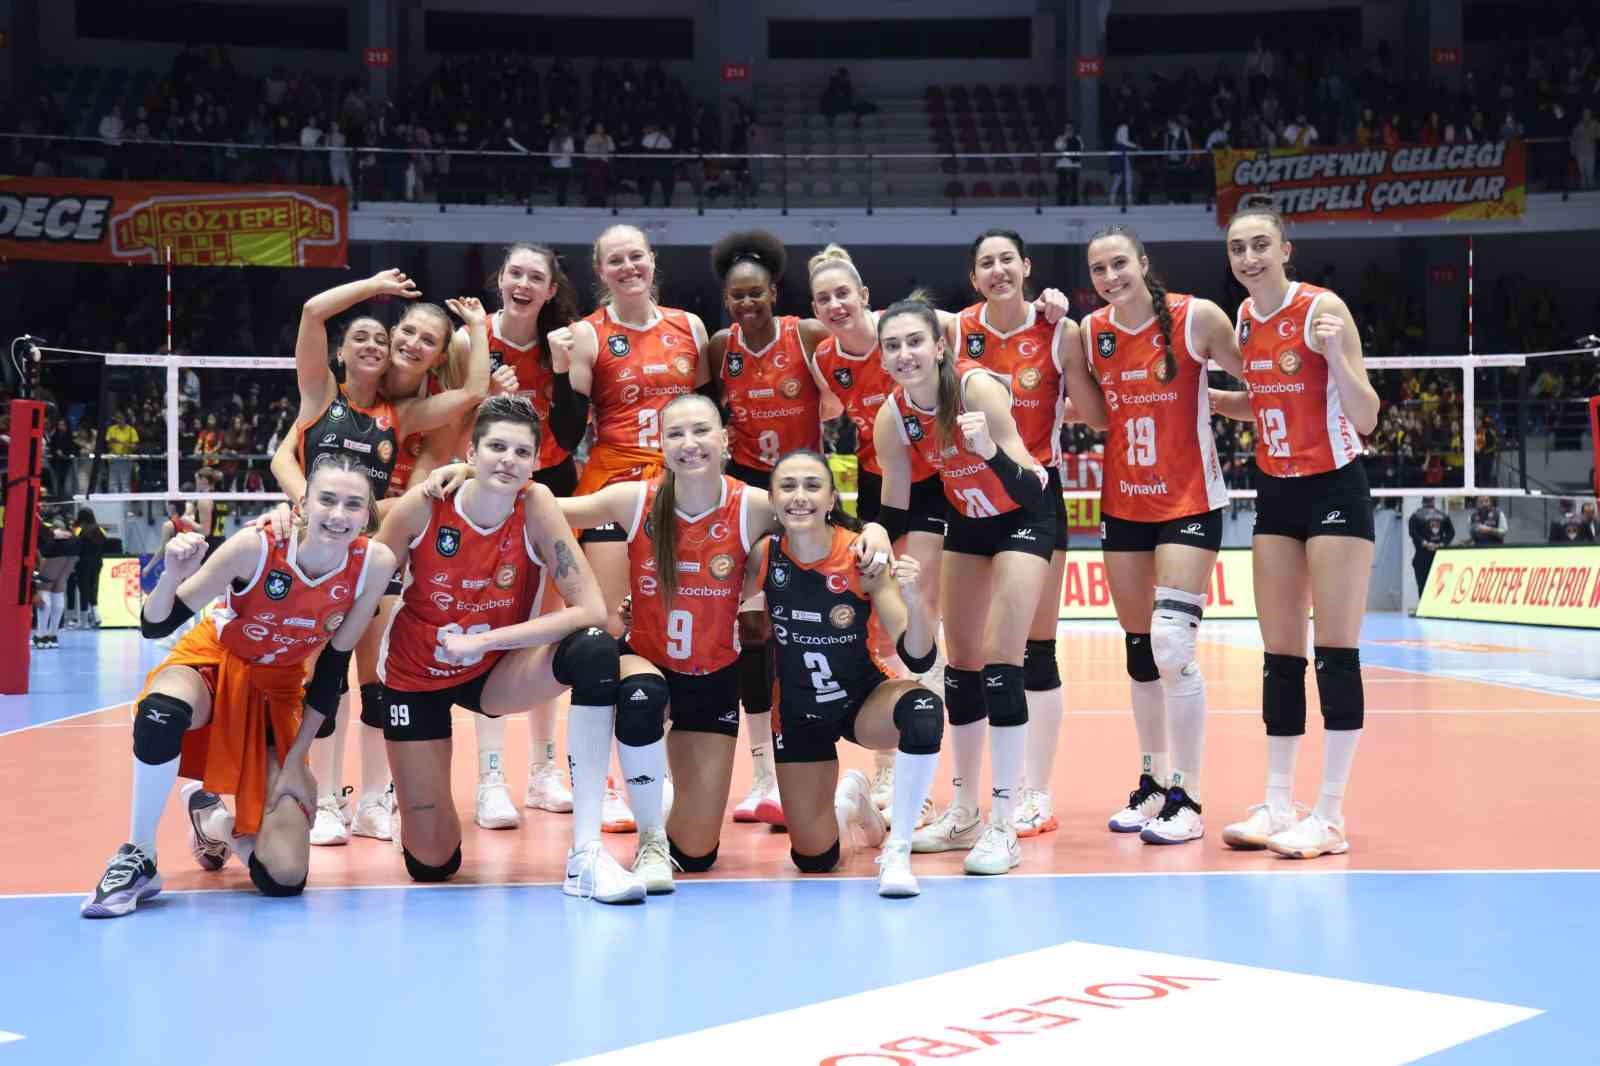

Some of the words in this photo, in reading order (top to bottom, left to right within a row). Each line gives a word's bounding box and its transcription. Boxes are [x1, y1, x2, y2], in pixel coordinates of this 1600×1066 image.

[1238, 179, 1367, 214] ZTEPELİ
[1371, 175, 1505, 213] ÇOCUKLAR
[162, 206, 289, 232] GÖZTEPE
[1124, 416, 1157, 467] 19
[1259, 408, 1290, 458] 12
[1119, 480, 1168, 497] Dynavit
[1523, 567, 1592, 608] VOLEYBOL
[666, 609, 693, 660] 9
[803, 651, 841, 693] 2
[389, 704, 410, 726] 99
